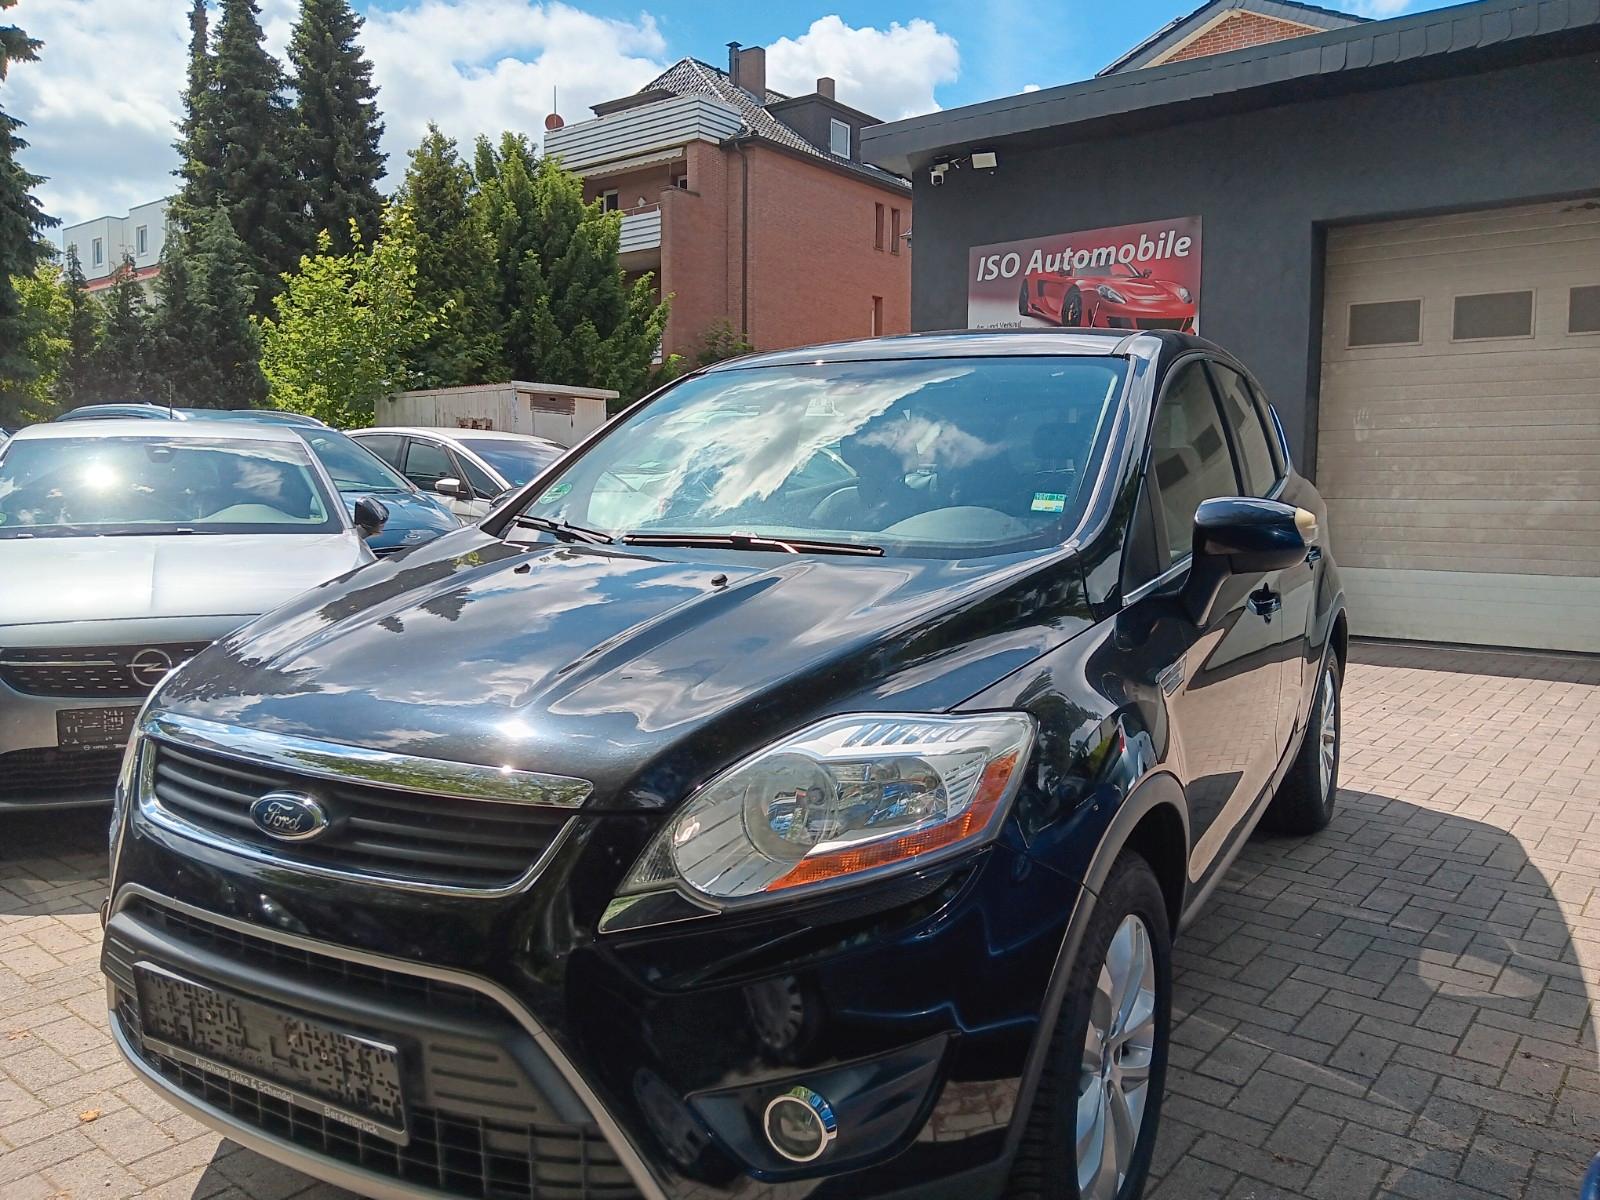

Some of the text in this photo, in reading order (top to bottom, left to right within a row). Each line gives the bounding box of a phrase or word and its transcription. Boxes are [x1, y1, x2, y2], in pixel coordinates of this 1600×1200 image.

[976, 230, 1192, 281] ISO Automobile
[263, 801, 304, 831] Ford
[195, 1057, 229, 1078] Autohaus
